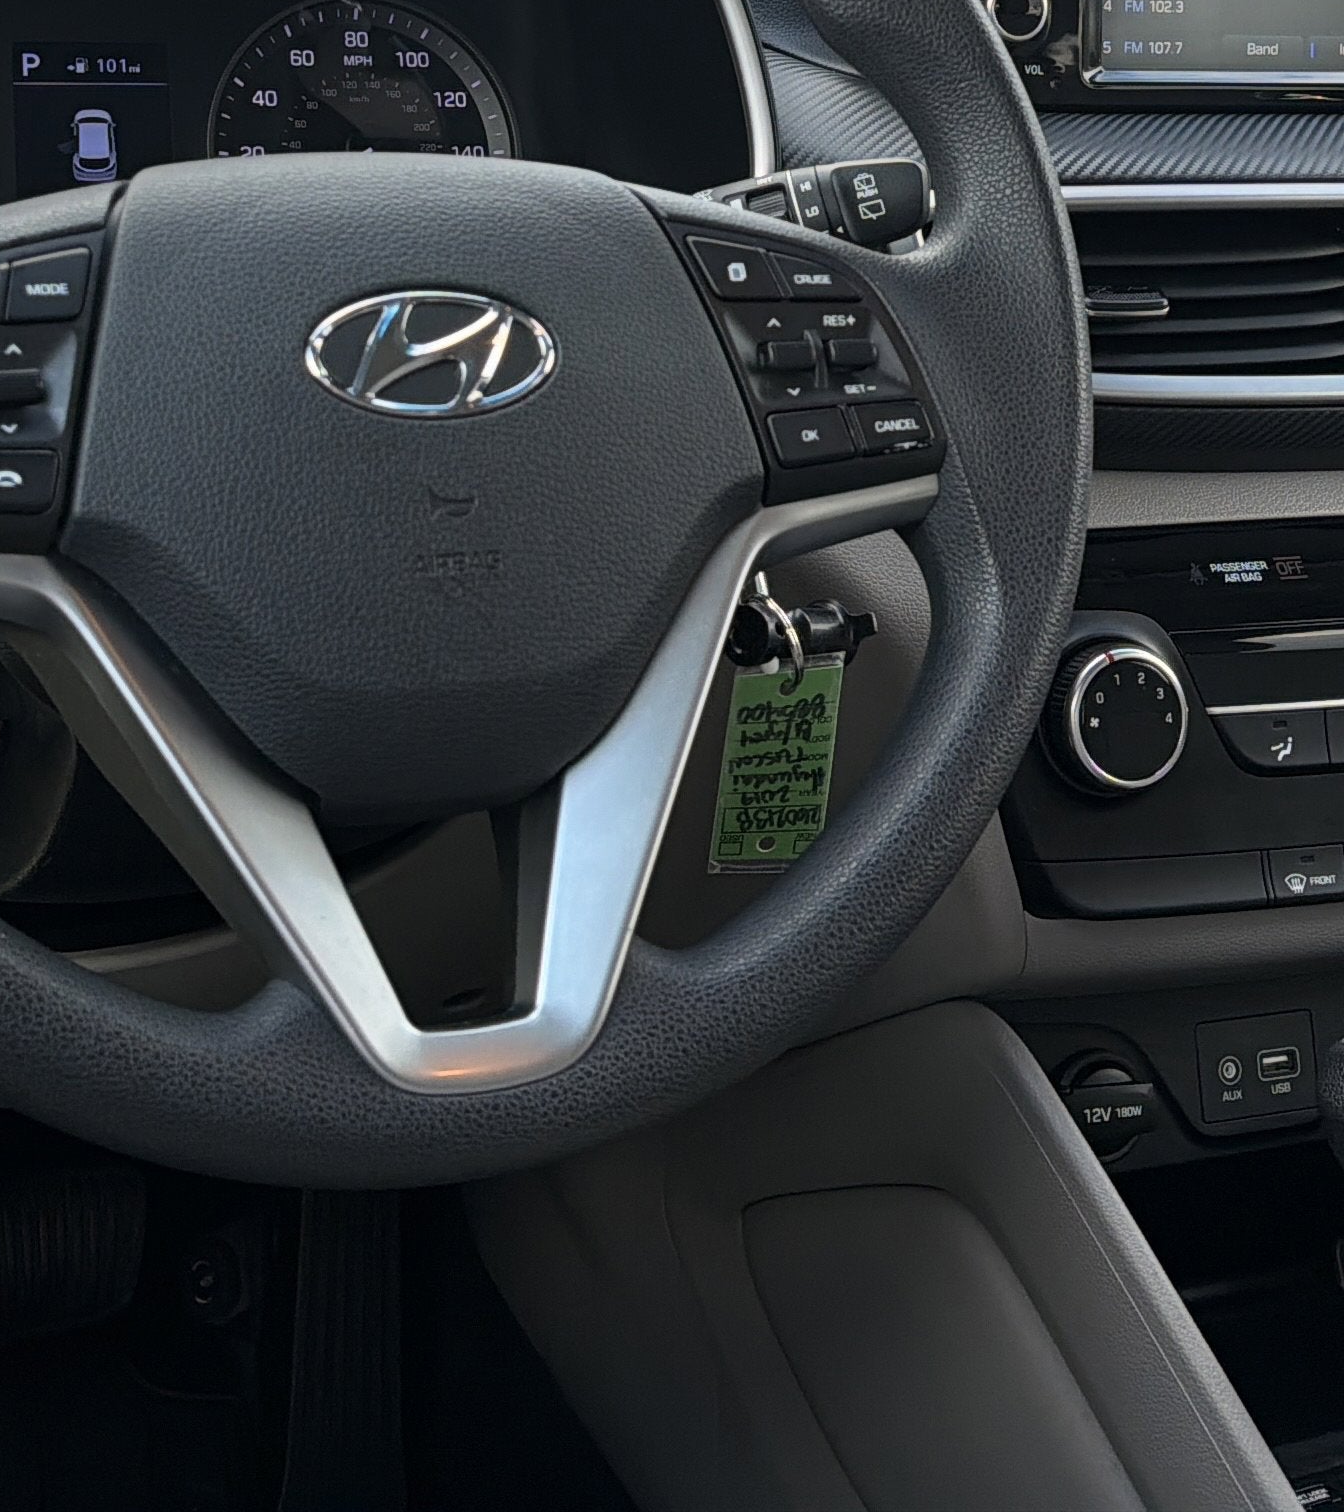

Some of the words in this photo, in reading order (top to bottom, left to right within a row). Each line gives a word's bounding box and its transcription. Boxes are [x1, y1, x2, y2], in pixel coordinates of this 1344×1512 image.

[1103, 0, 1112, 12] 4
[1124, 0, 1144, 13] FM
[1149, 0, 1184, 13] 102.3
[344, 31, 369, 48] 80
[1103, 41, 1112, 54] 5
[1124, 41, 1143, 54] FM
[1148, 42, 1183, 54] 107.7
[1247, 43, 1279, 56] Band
[290, 50, 315, 67] 60
[343, 55, 373, 67] MPH
[395, 51, 430, 68] 100
[21, 53, 41, 77] P
[96, 58, 127, 73] 101
[1024, 64, 1045, 76] VOL
[342, 80, 358, 89] 120
[364, 80, 381, 89] 140
[252, 90, 278, 107] 40
[321, 88, 338, 97] 100
[385, 90, 402, 99] 160
[306, 100, 319, 110] 80
[433, 91, 467, 108] 120
[401, 104, 418, 114] 180
[294, 119, 307, 129] 60
[413, 122, 430, 132] 200
[289, 140, 302, 149] 40
[25, 283, 69, 295] MODE
[875, 418, 920, 433] CANCEL
[801, 429, 819, 442] OK
[1209, 561, 1268, 572] PASSENGER
[1276, 560, 1304, 576] OFF
[1113, 674, 1121, 686] 1
[1137, 672, 1146, 685] 2
[1096, 691, 1105, 704] 0
[1156, 687, 1165, 700] 3
[1165, 712, 1173, 724] 4
[1309, 875, 1337, 886] FRONT
[1271, 1082, 1292, 1094] USB
[1222, 1090, 1244, 1102] AUX
[1083, 1107, 1112, 1124] 12V
[1114, 1104, 1143, 1119] 180W
